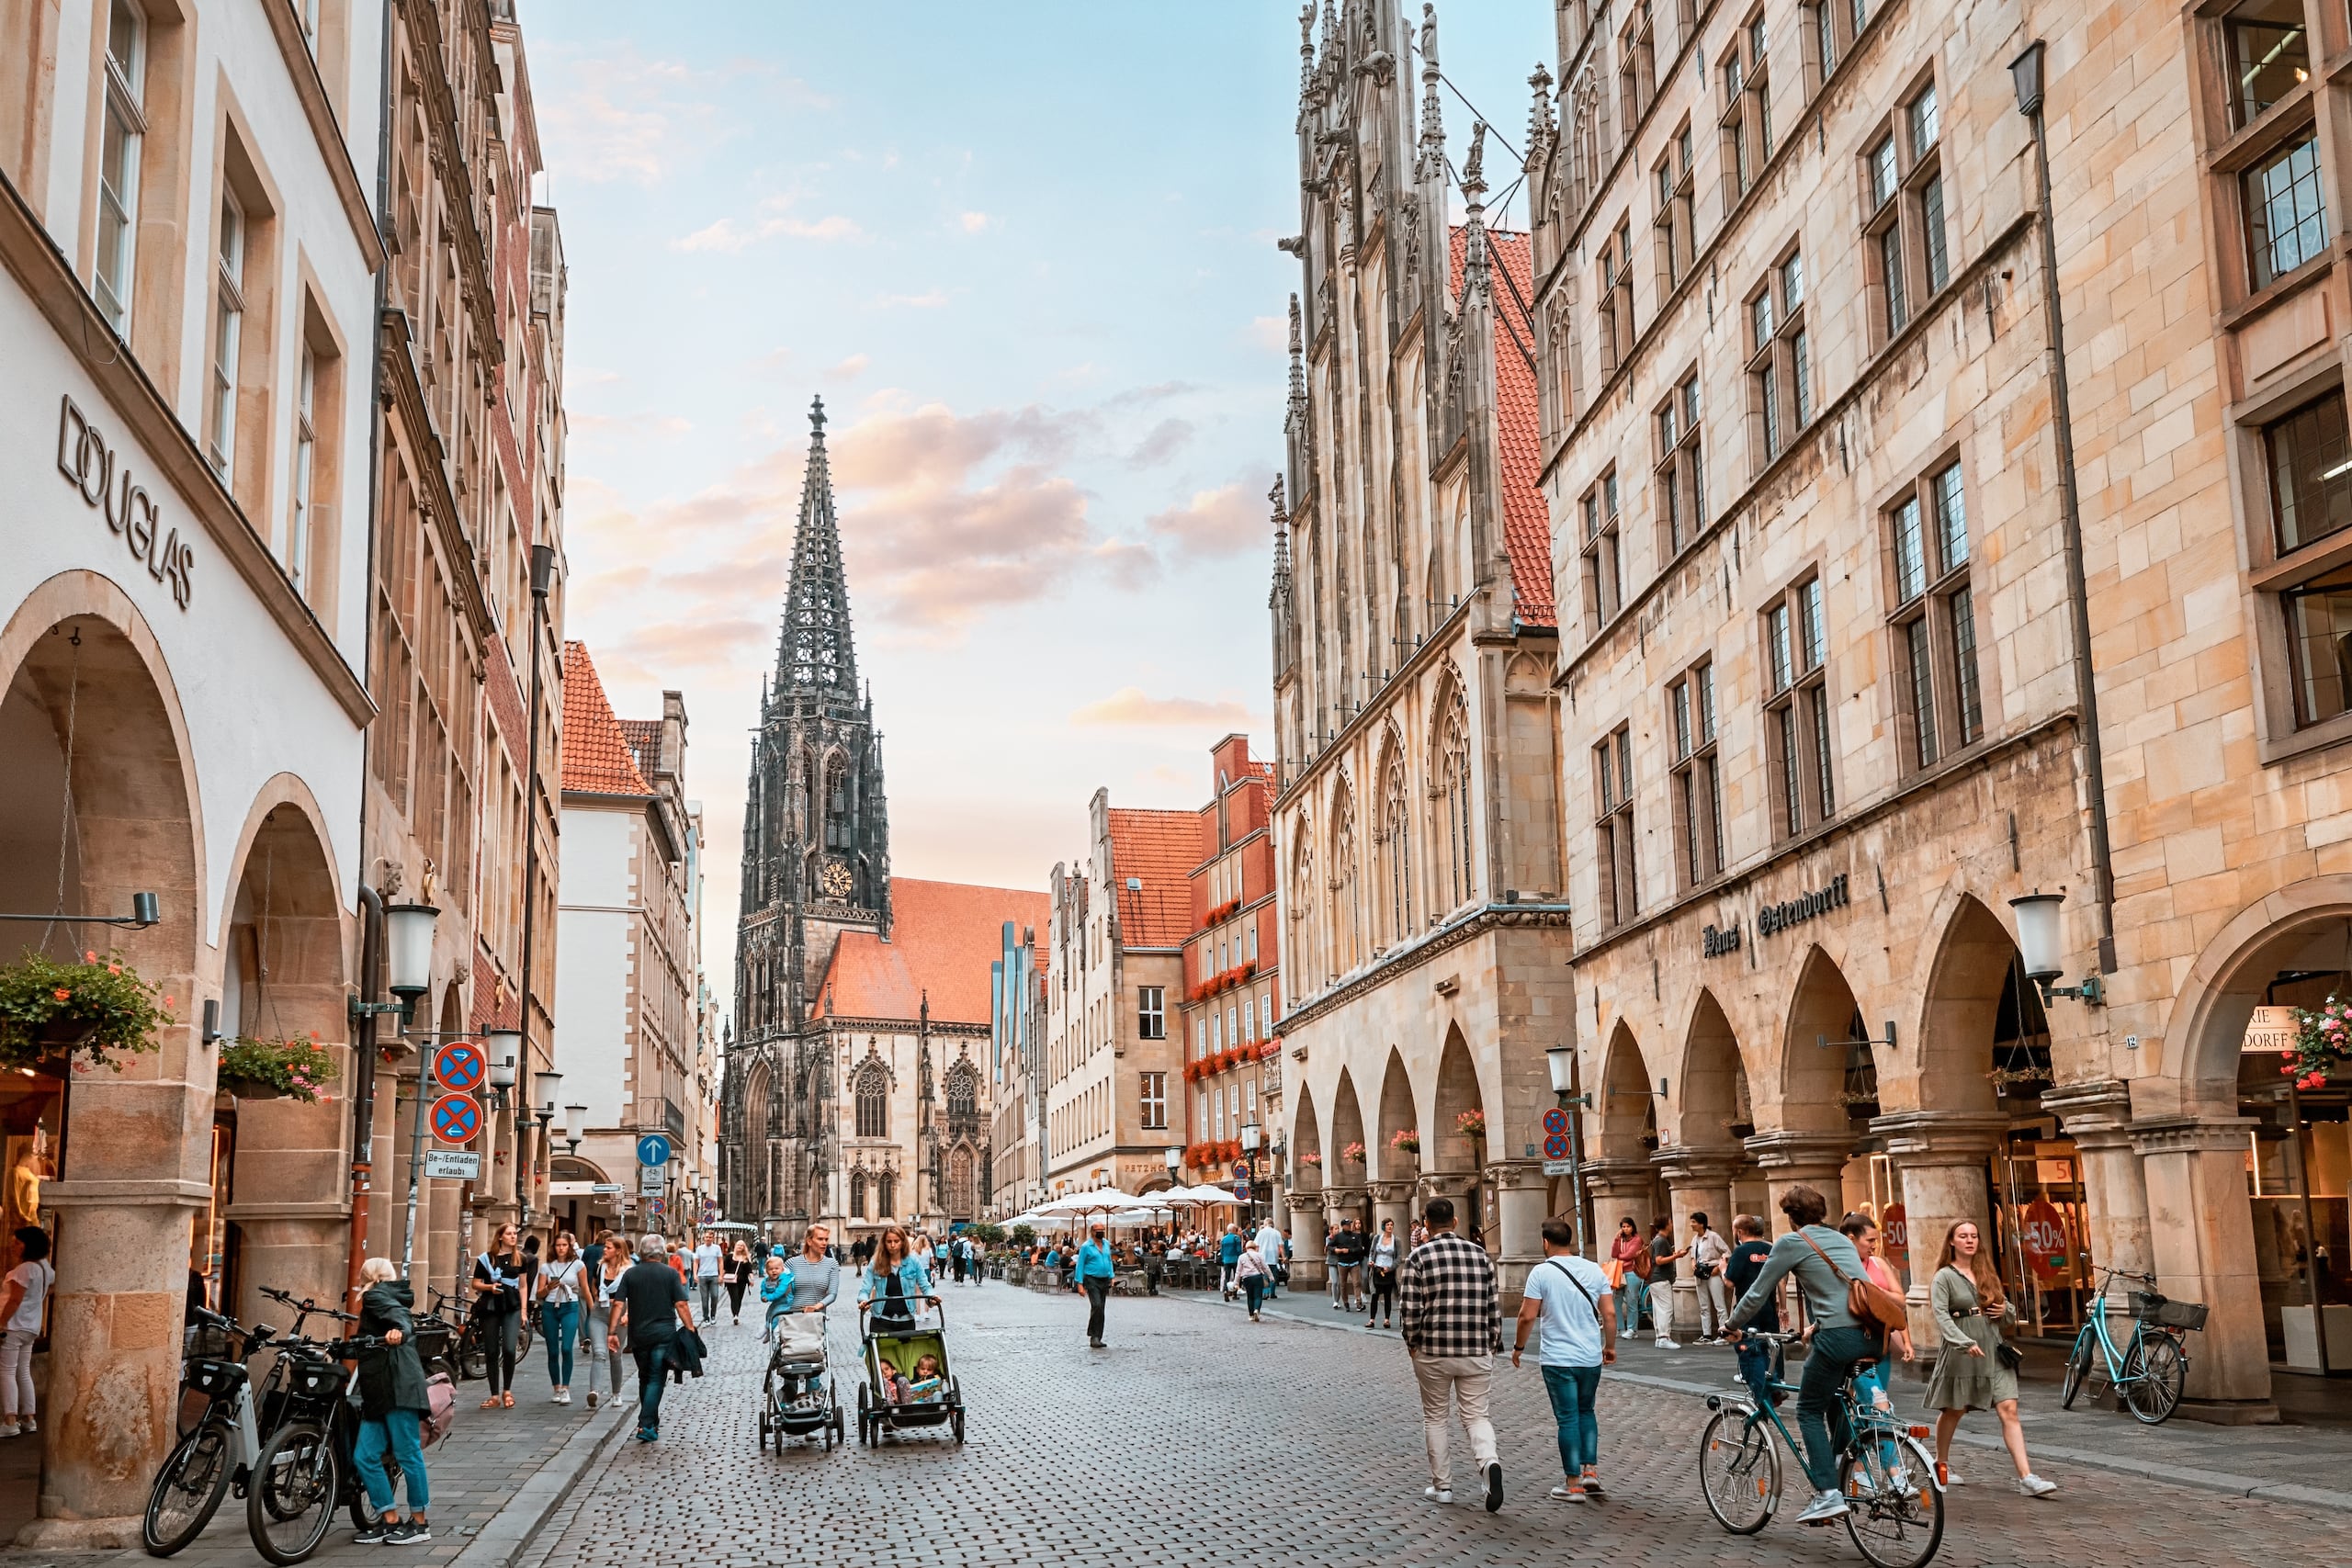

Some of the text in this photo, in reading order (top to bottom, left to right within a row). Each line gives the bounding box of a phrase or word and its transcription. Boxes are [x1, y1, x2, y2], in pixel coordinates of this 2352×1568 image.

[57, 393, 195, 611] DOUGLAS
[1702, 923, 1739, 959] Haus
[2127, 1036, 2136, 1047] 12
[2242, 1032, 2288, 1047] DORFF
[428, 1153, 478, 1165] Be-/Entladen
[1125, 1164, 1170, 1173] PETZHO
[2024, 1220, 2064, 1249] -50%
